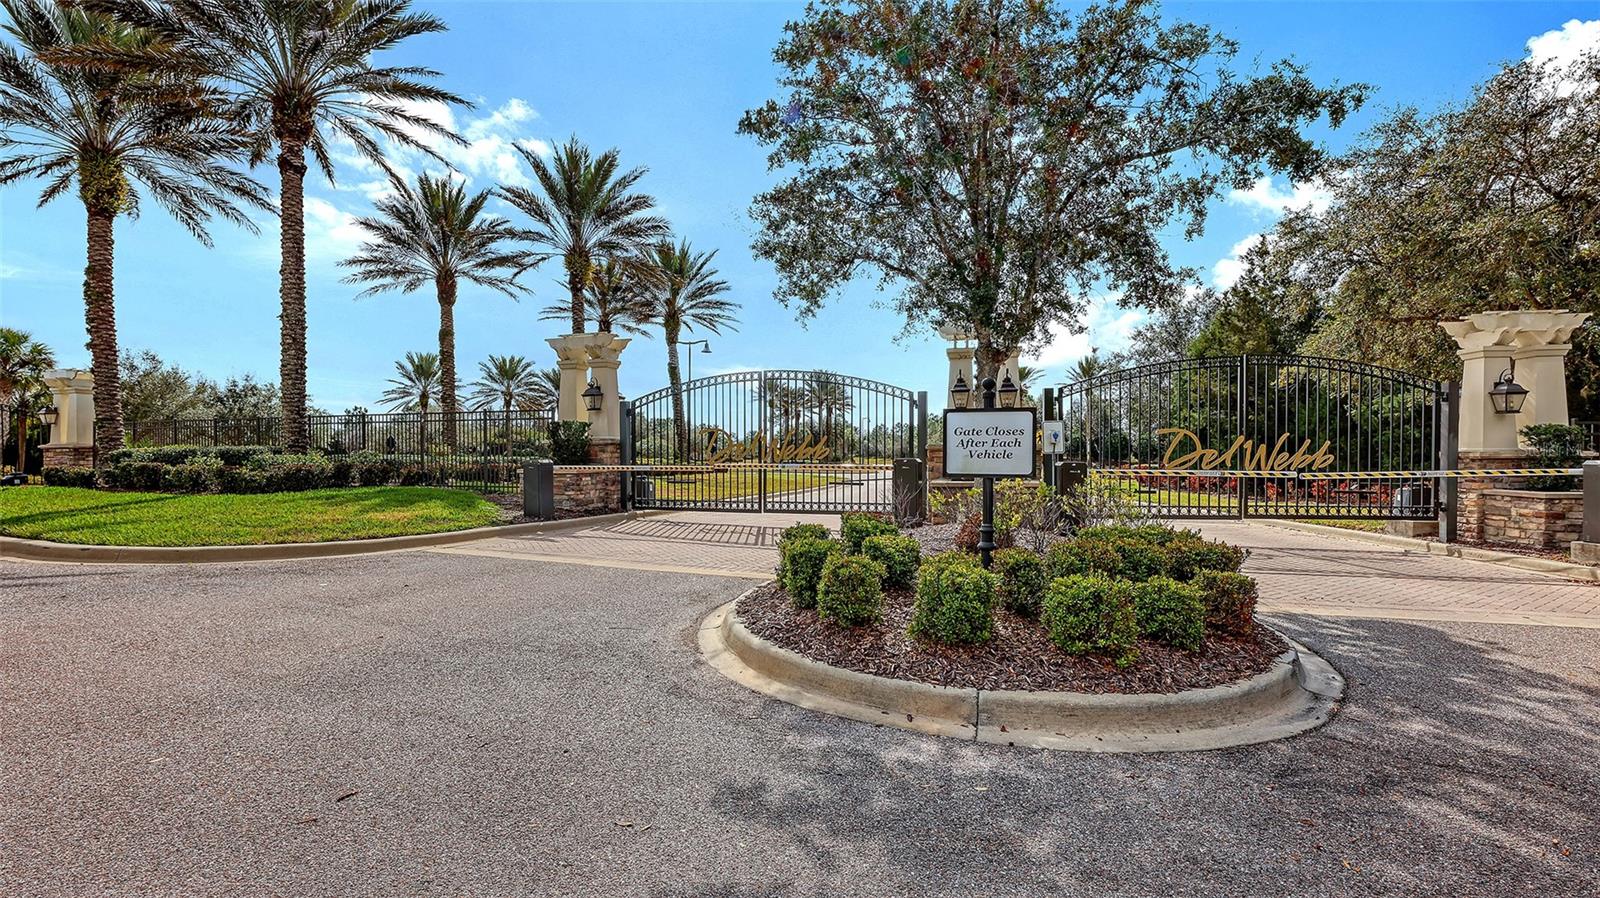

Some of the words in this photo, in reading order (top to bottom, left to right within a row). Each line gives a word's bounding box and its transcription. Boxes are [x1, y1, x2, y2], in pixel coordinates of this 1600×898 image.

[954, 426, 983, 436] Gate
[985, 426, 1025, 436] Closes
[759, 427, 831, 463] Webb
[956, 437, 988, 449] After
[991, 437, 1022, 448] Each
[1156, 427, 1246, 471] Del
[1243, 432, 1335, 471] Webb
[968, 449, 1014, 460] Vehicle
